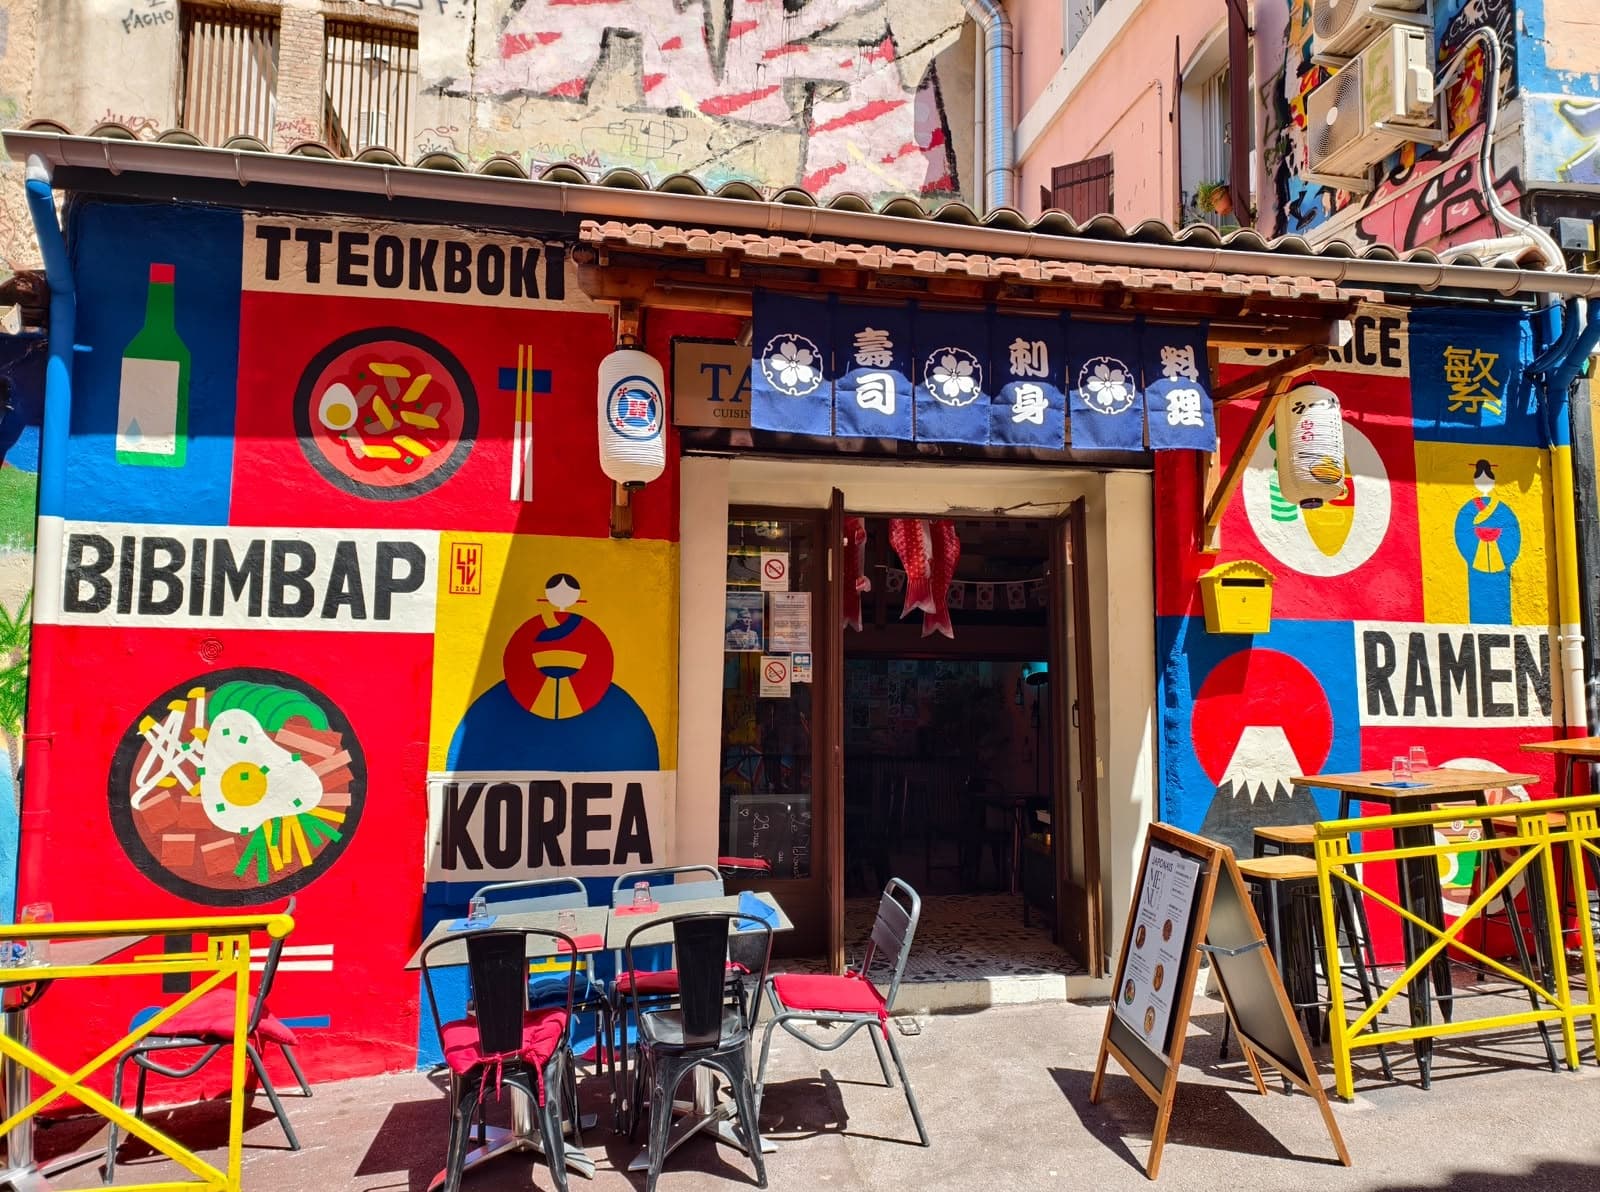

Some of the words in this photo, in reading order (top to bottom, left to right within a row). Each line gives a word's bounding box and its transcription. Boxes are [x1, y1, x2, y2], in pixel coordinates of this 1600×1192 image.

[256, 225, 565, 301] TTEOKBOKI
[1009, 337, 1049, 425] 刺身
[1160, 344, 1205, 428] 料理
[63, 533, 427, 621] BIBIMBAP
[1363, 630, 1553, 718] RAMEN
[441, 780, 654, 870] KOREA
